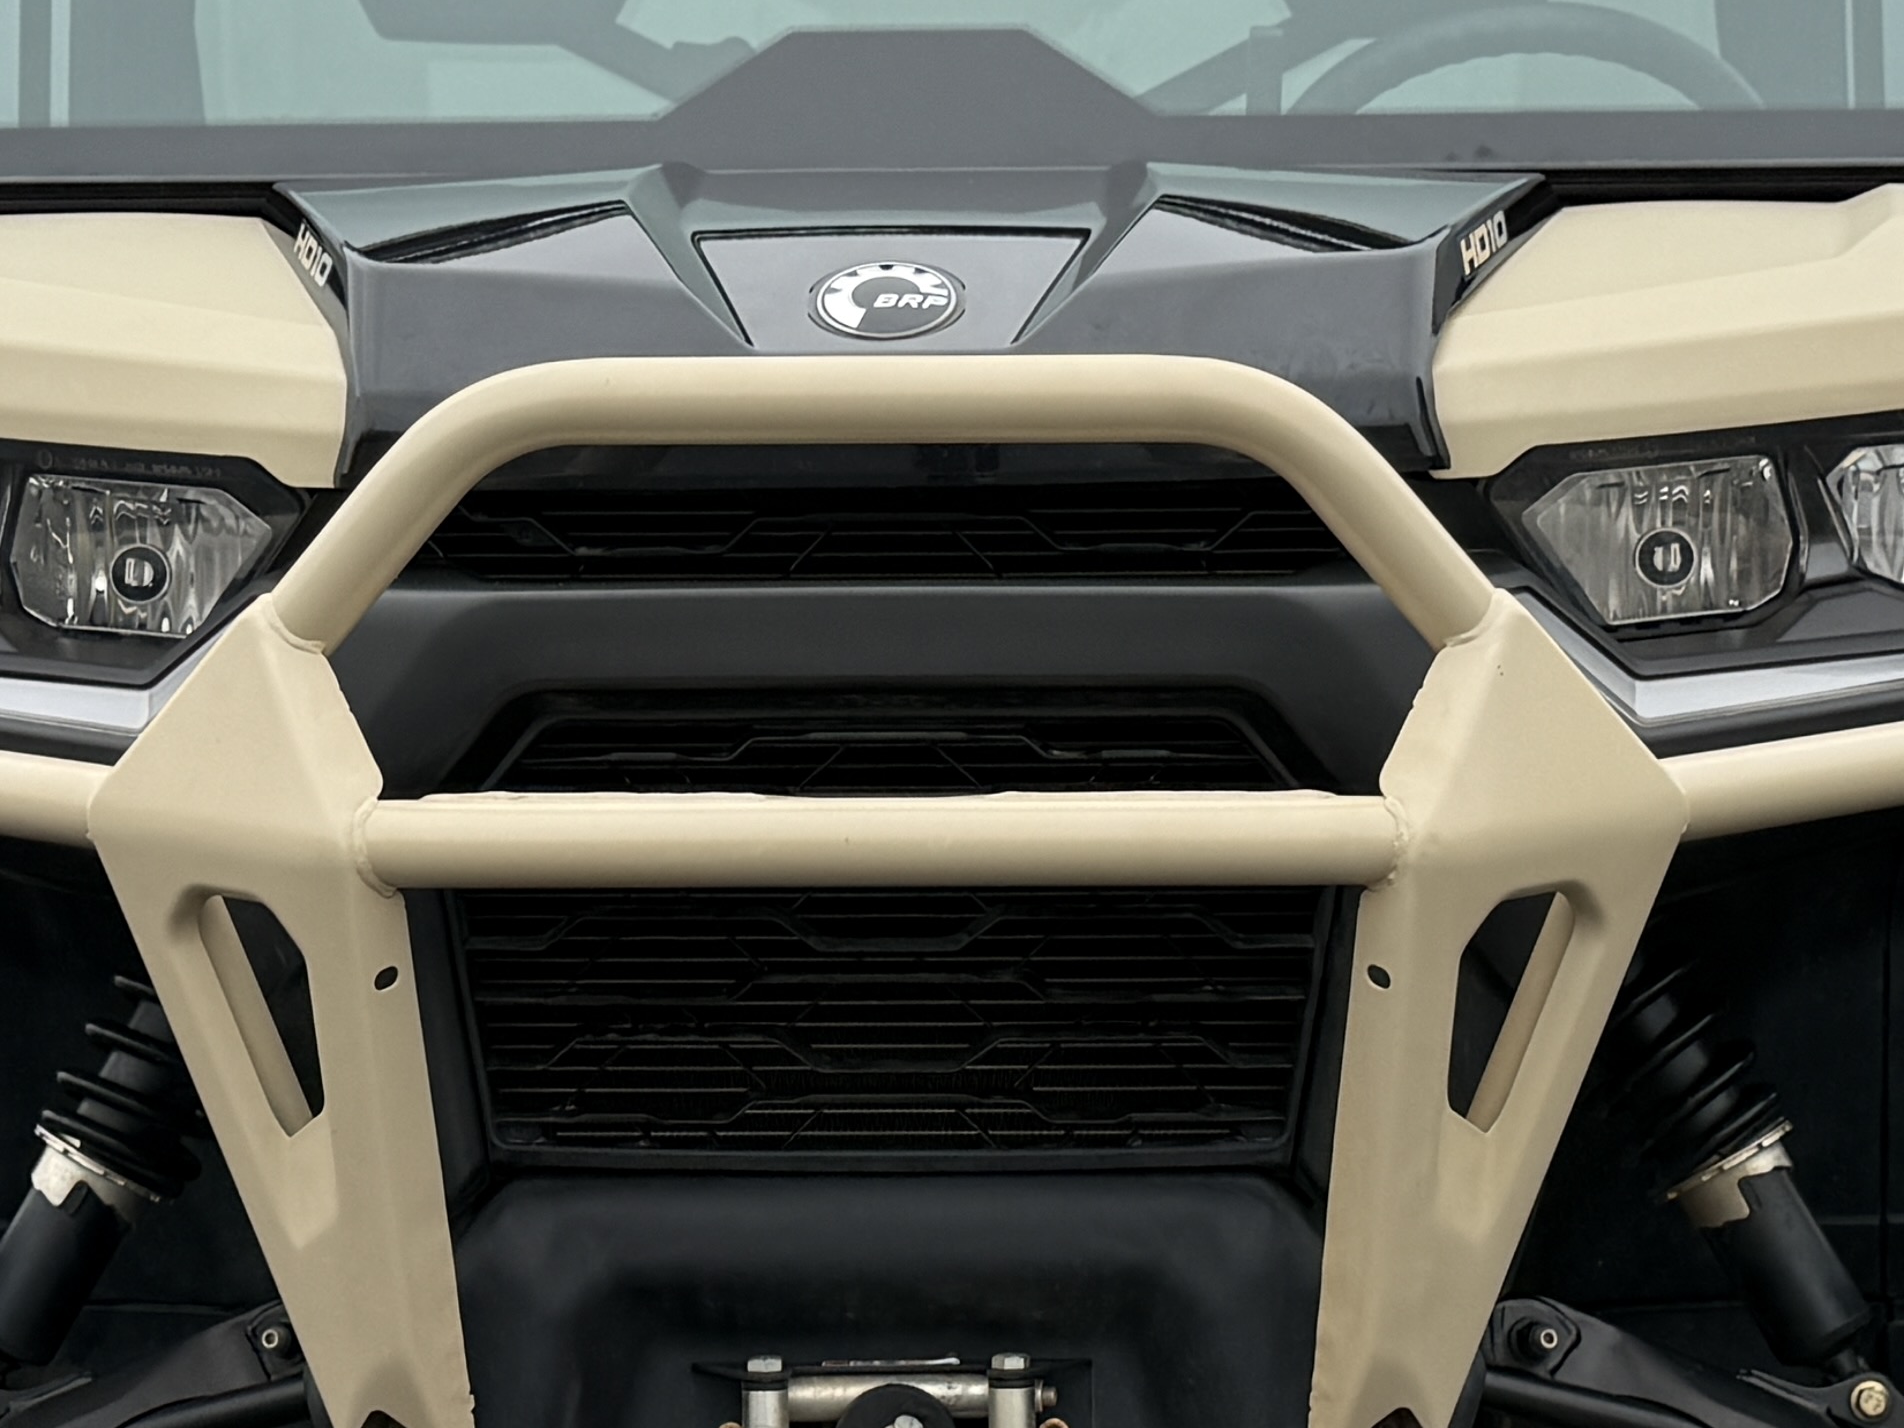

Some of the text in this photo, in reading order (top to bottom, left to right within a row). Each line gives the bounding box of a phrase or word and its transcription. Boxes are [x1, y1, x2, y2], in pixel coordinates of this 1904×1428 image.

[293, 223, 333, 287] HD10
[1460, 210, 1508, 276] HD10
[873, 293, 949, 309] BRP
